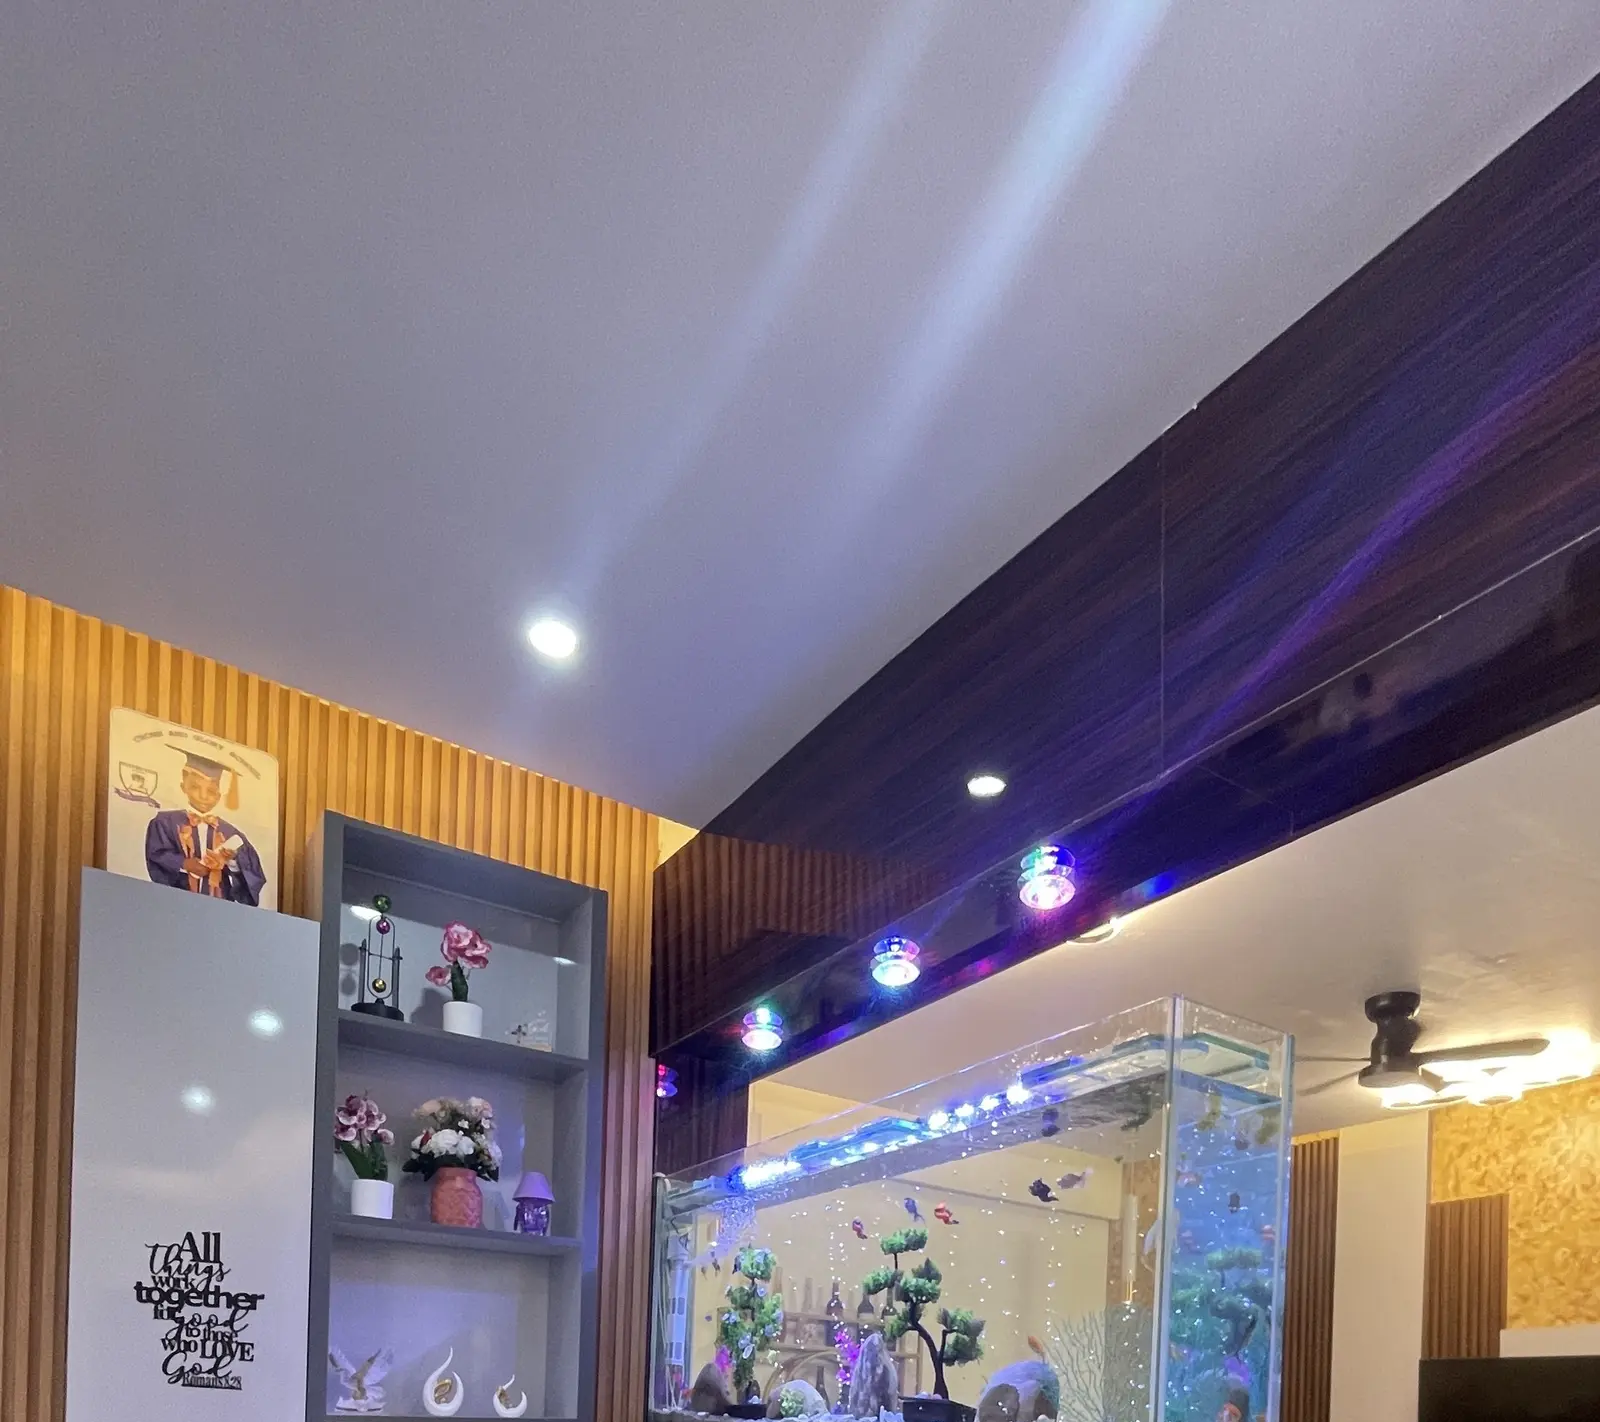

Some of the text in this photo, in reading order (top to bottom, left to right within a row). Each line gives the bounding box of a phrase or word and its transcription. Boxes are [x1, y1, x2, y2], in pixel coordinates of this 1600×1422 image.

[177, 1231, 221, 1263] All
[134, 1281, 264, 1310] together
[151, 1275, 195, 1290] work
[153, 1304, 181, 1320] for
[166, 1307, 249, 1342] good
[185, 1324, 238, 1343] to those
[160, 1338, 254, 1362] who LOVE
[161, 1350, 232, 1384] God
